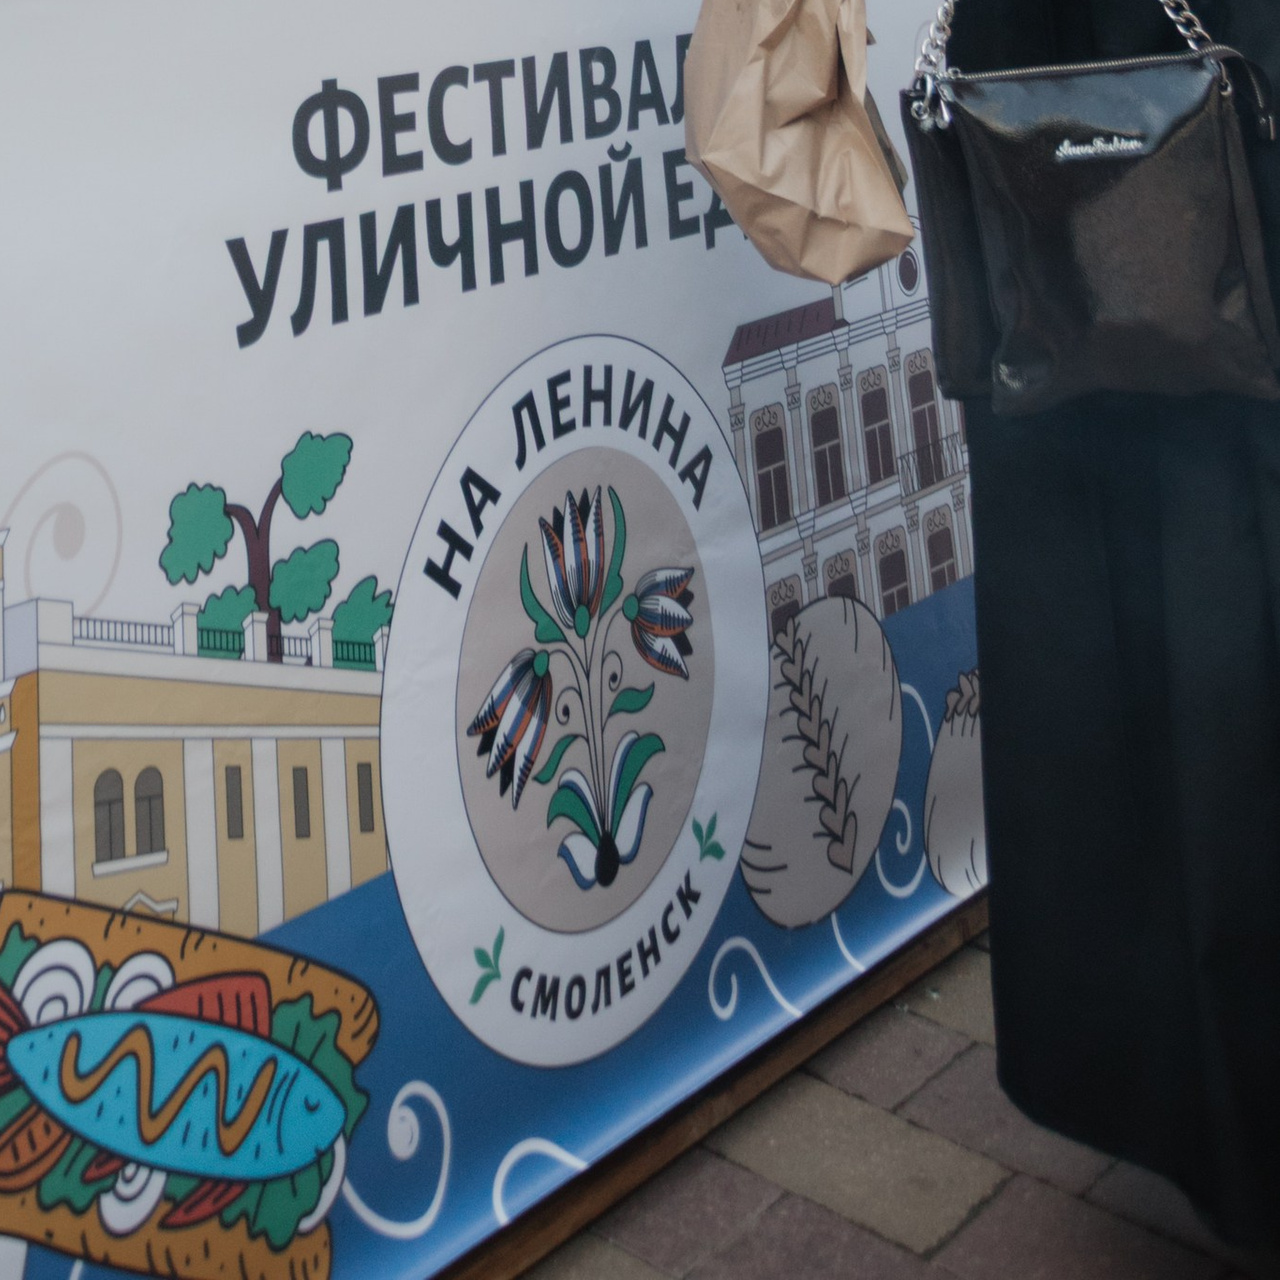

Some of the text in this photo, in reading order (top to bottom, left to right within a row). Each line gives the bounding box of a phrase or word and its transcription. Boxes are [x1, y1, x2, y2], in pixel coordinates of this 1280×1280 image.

[224, 142, 649, 350] УЛИЧНОЙ
[423, 363, 714, 600] НА ЛЕНИНА
[509, 870, 702, 1023] СМОЛЕНСК
